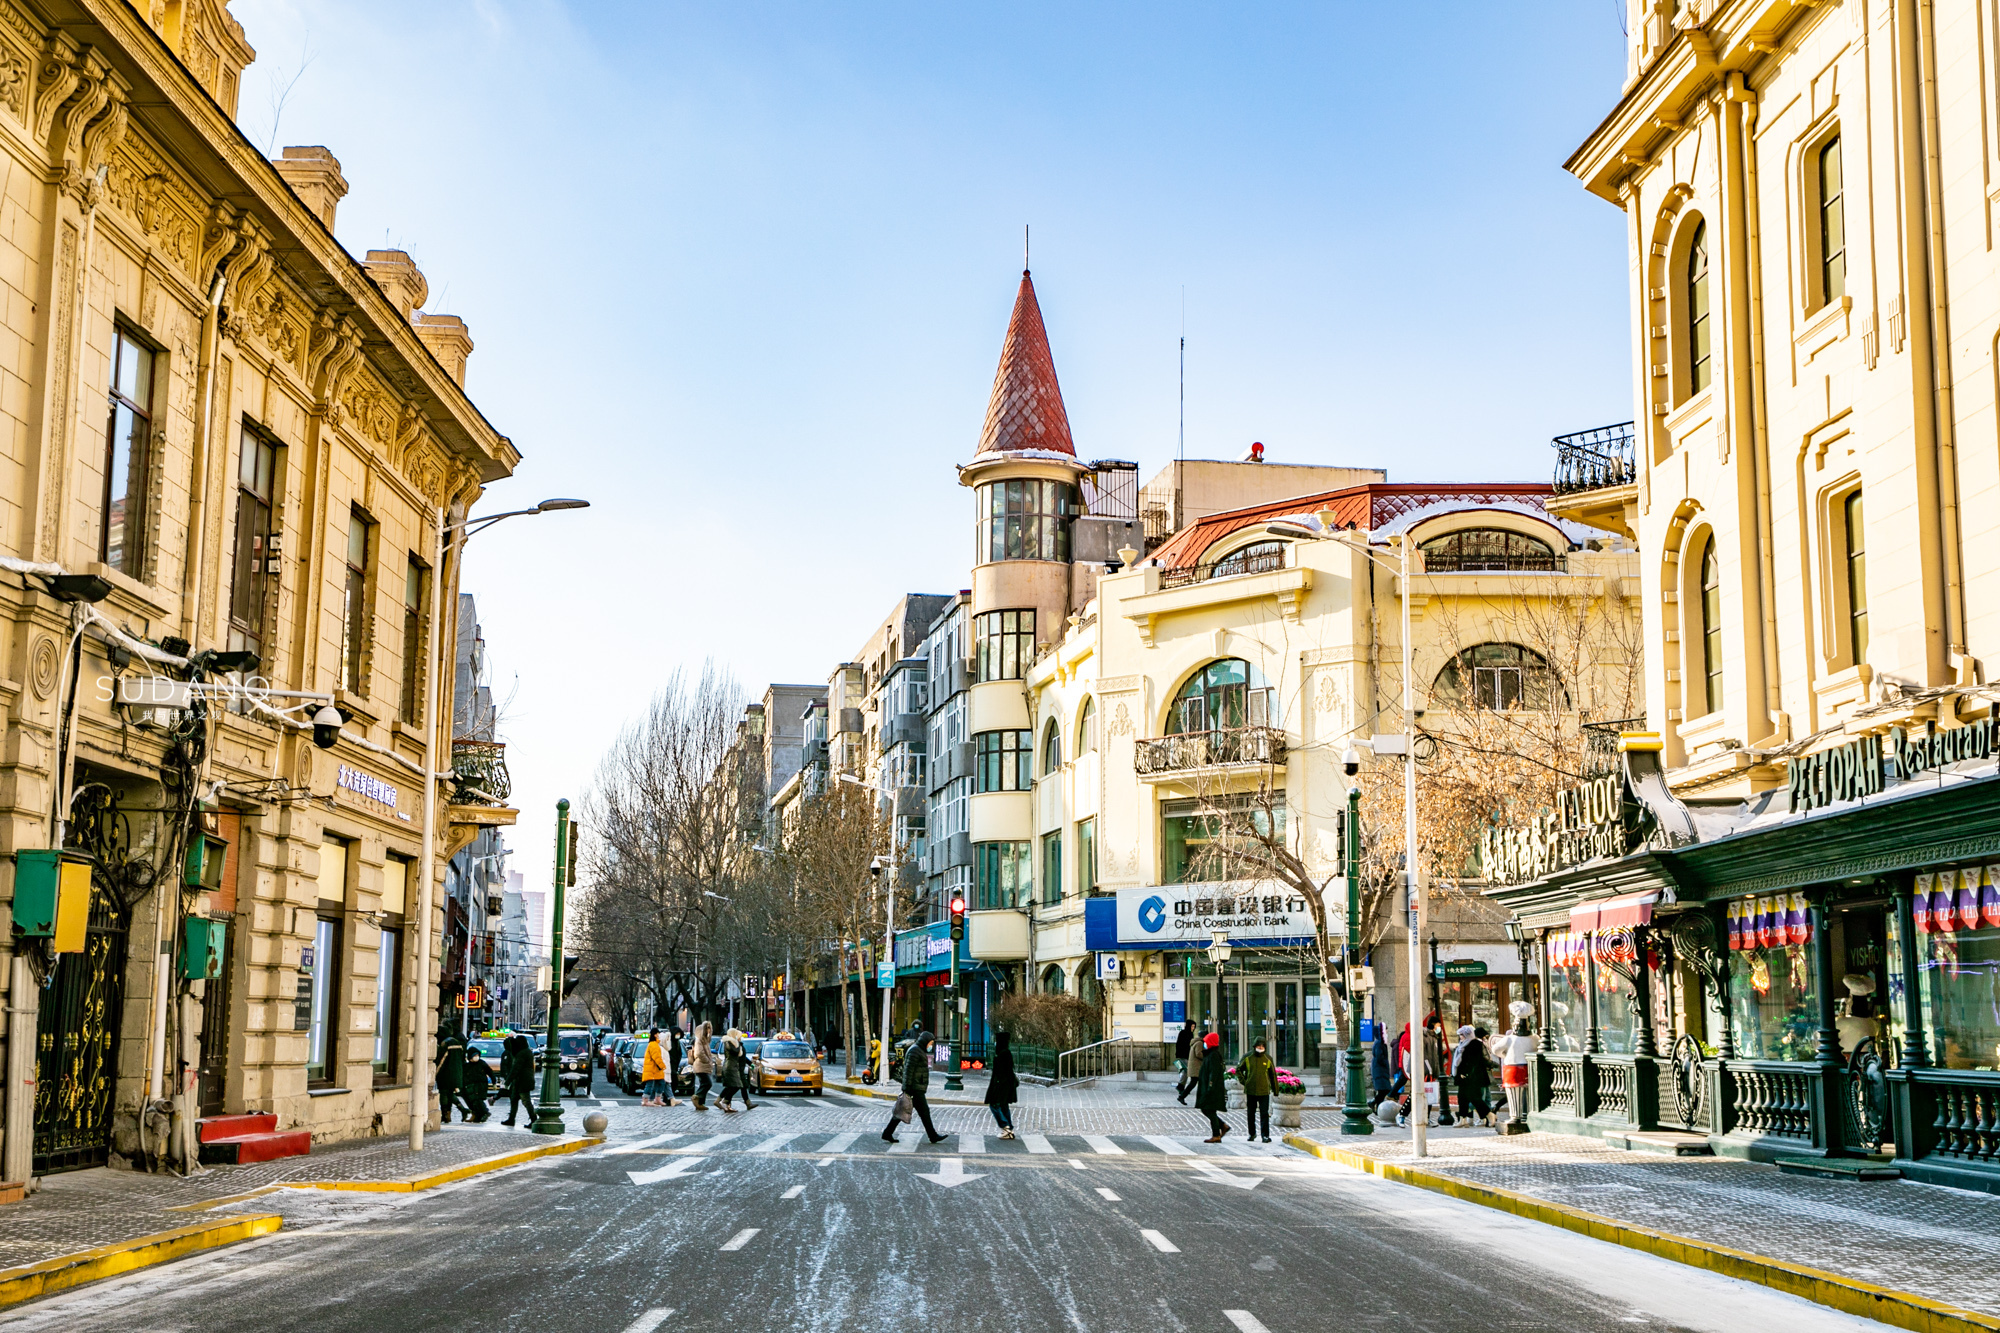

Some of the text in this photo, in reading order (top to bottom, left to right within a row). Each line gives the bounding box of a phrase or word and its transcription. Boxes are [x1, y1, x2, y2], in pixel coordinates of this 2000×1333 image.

[1891, 703, 1996, 781] Restaurant
[1174, 895, 1305, 917] 中国建设银行
[1174, 916, 1289, 930] China Construction Bank
